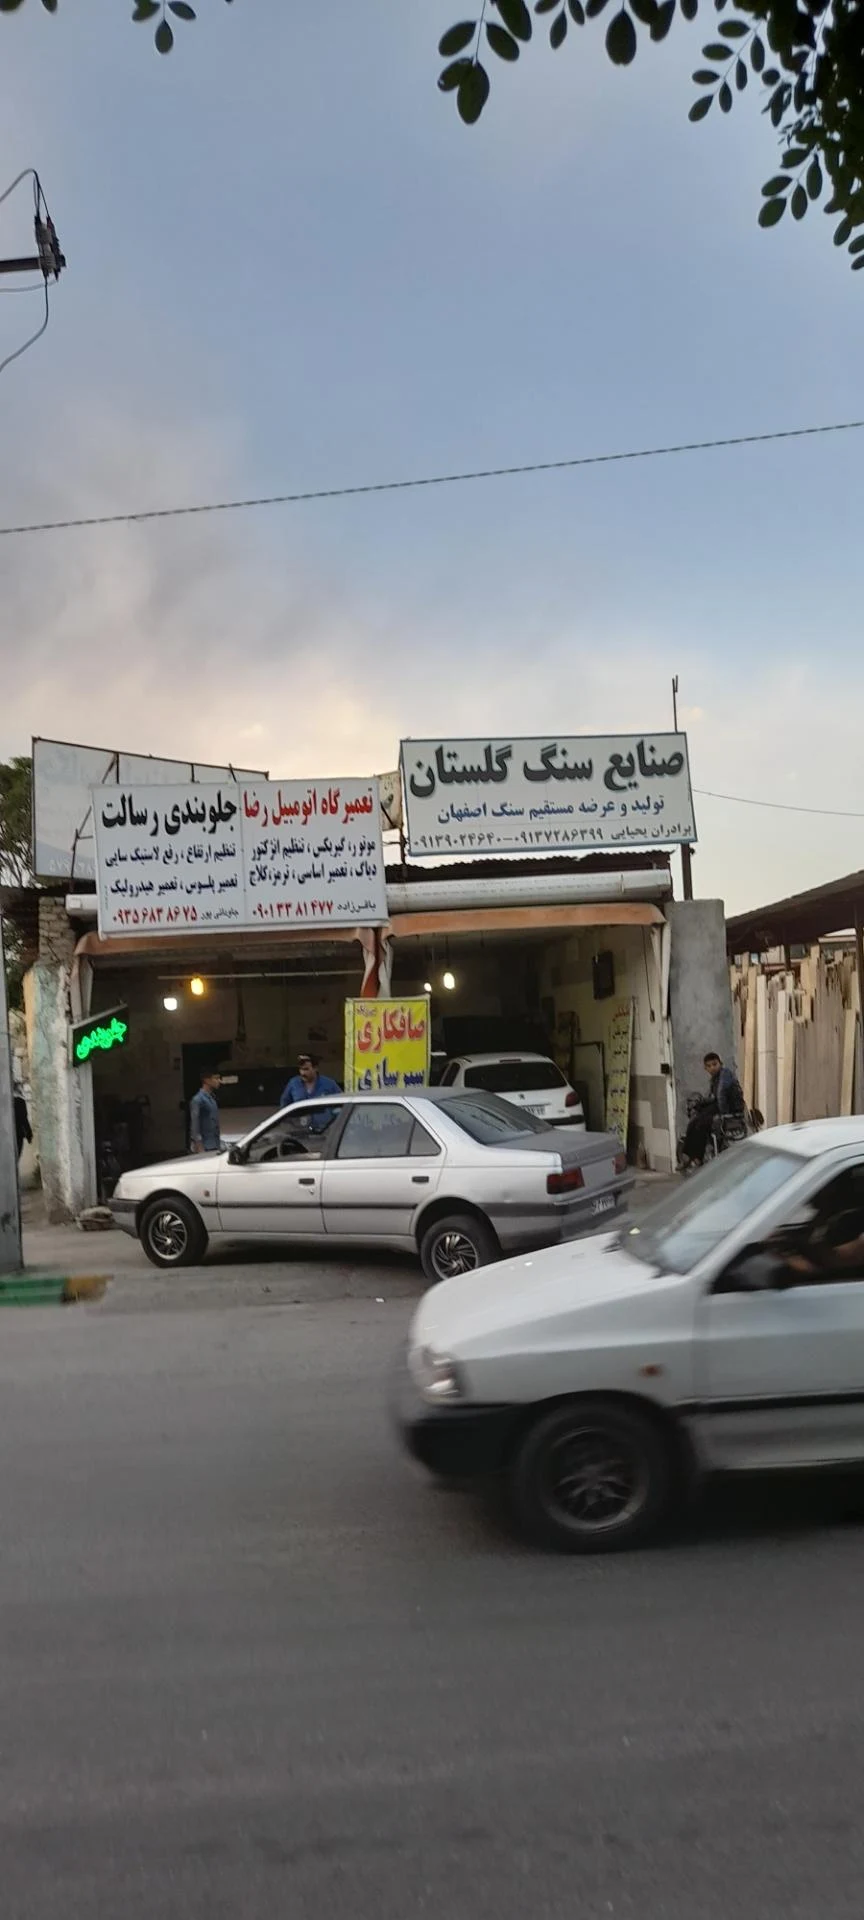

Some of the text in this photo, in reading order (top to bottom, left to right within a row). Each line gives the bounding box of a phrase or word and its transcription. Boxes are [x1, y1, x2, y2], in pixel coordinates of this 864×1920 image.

[409, 743, 512, 798] گلستان
[523, 743, 593, 782] سنگ
[603, 739, 684, 791] صنایع
[101, 790, 238, 836] جلوبندی رسالت
[243, 789, 268, 827] رضا
[271, 787, 318, 826] اتومبیل
[438, 802, 487, 824] اصفهان
[529, 801, 574, 821] مستقیم
[578, 798, 615, 818] عرضه
[620, 803, 628, 817] و
[631, 795, 665, 815] تولید
[651, 822, 691, 839] برادران
[130, 845, 160, 866] لاستیک
[213, 842, 236, 863] تنظیم
[282, 836, 305, 860] تنظیم
[327, 860, 349, 884] تعمیر
[110, 878, 154, 898] هیدرولیک
[157, 876, 179, 897] تعمیر
[217, 873, 238, 894] تعمیر
[356, 1005, 426, 1053] صافکاری
